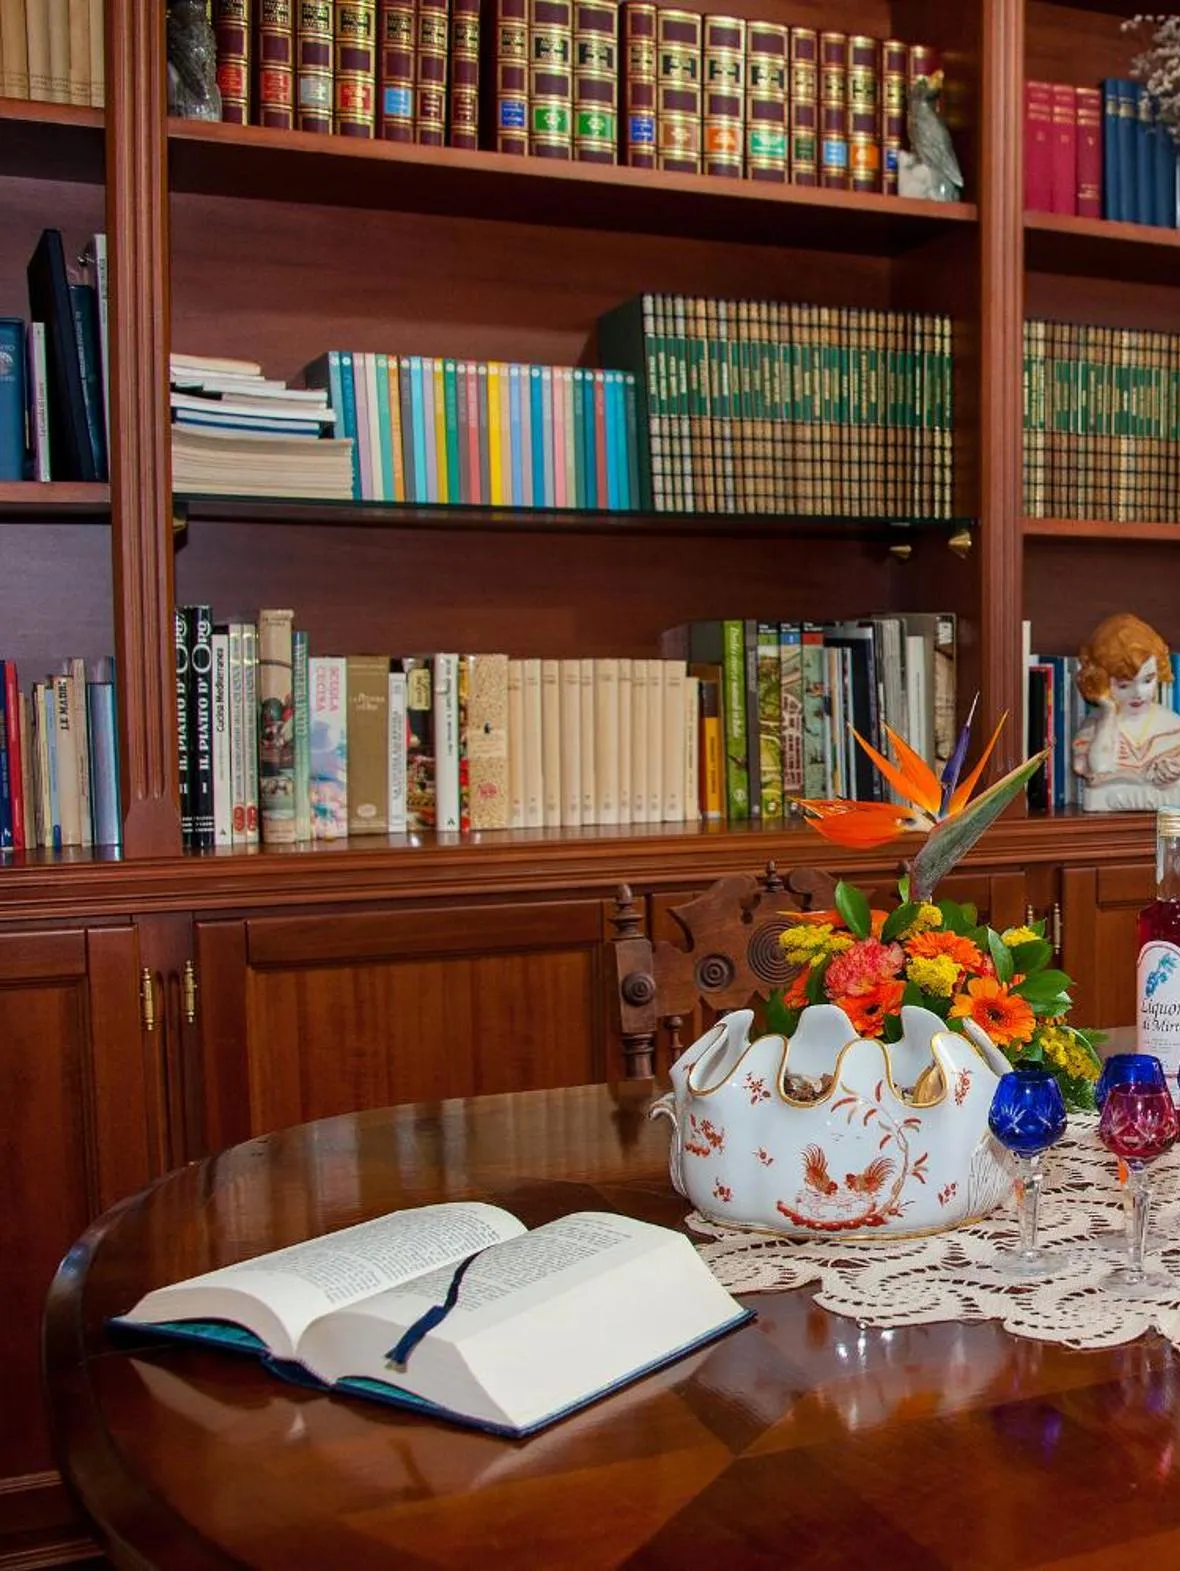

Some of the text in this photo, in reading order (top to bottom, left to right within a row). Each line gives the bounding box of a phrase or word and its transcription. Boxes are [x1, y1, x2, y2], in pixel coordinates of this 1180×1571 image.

[216, 647, 226, 703] Mediterranea
[176, 698, 188, 752] PIATTO
[198, 697, 209, 752] PIATTO
[216, 703, 226, 733] Cucina
[199, 756, 210, 770] IL
